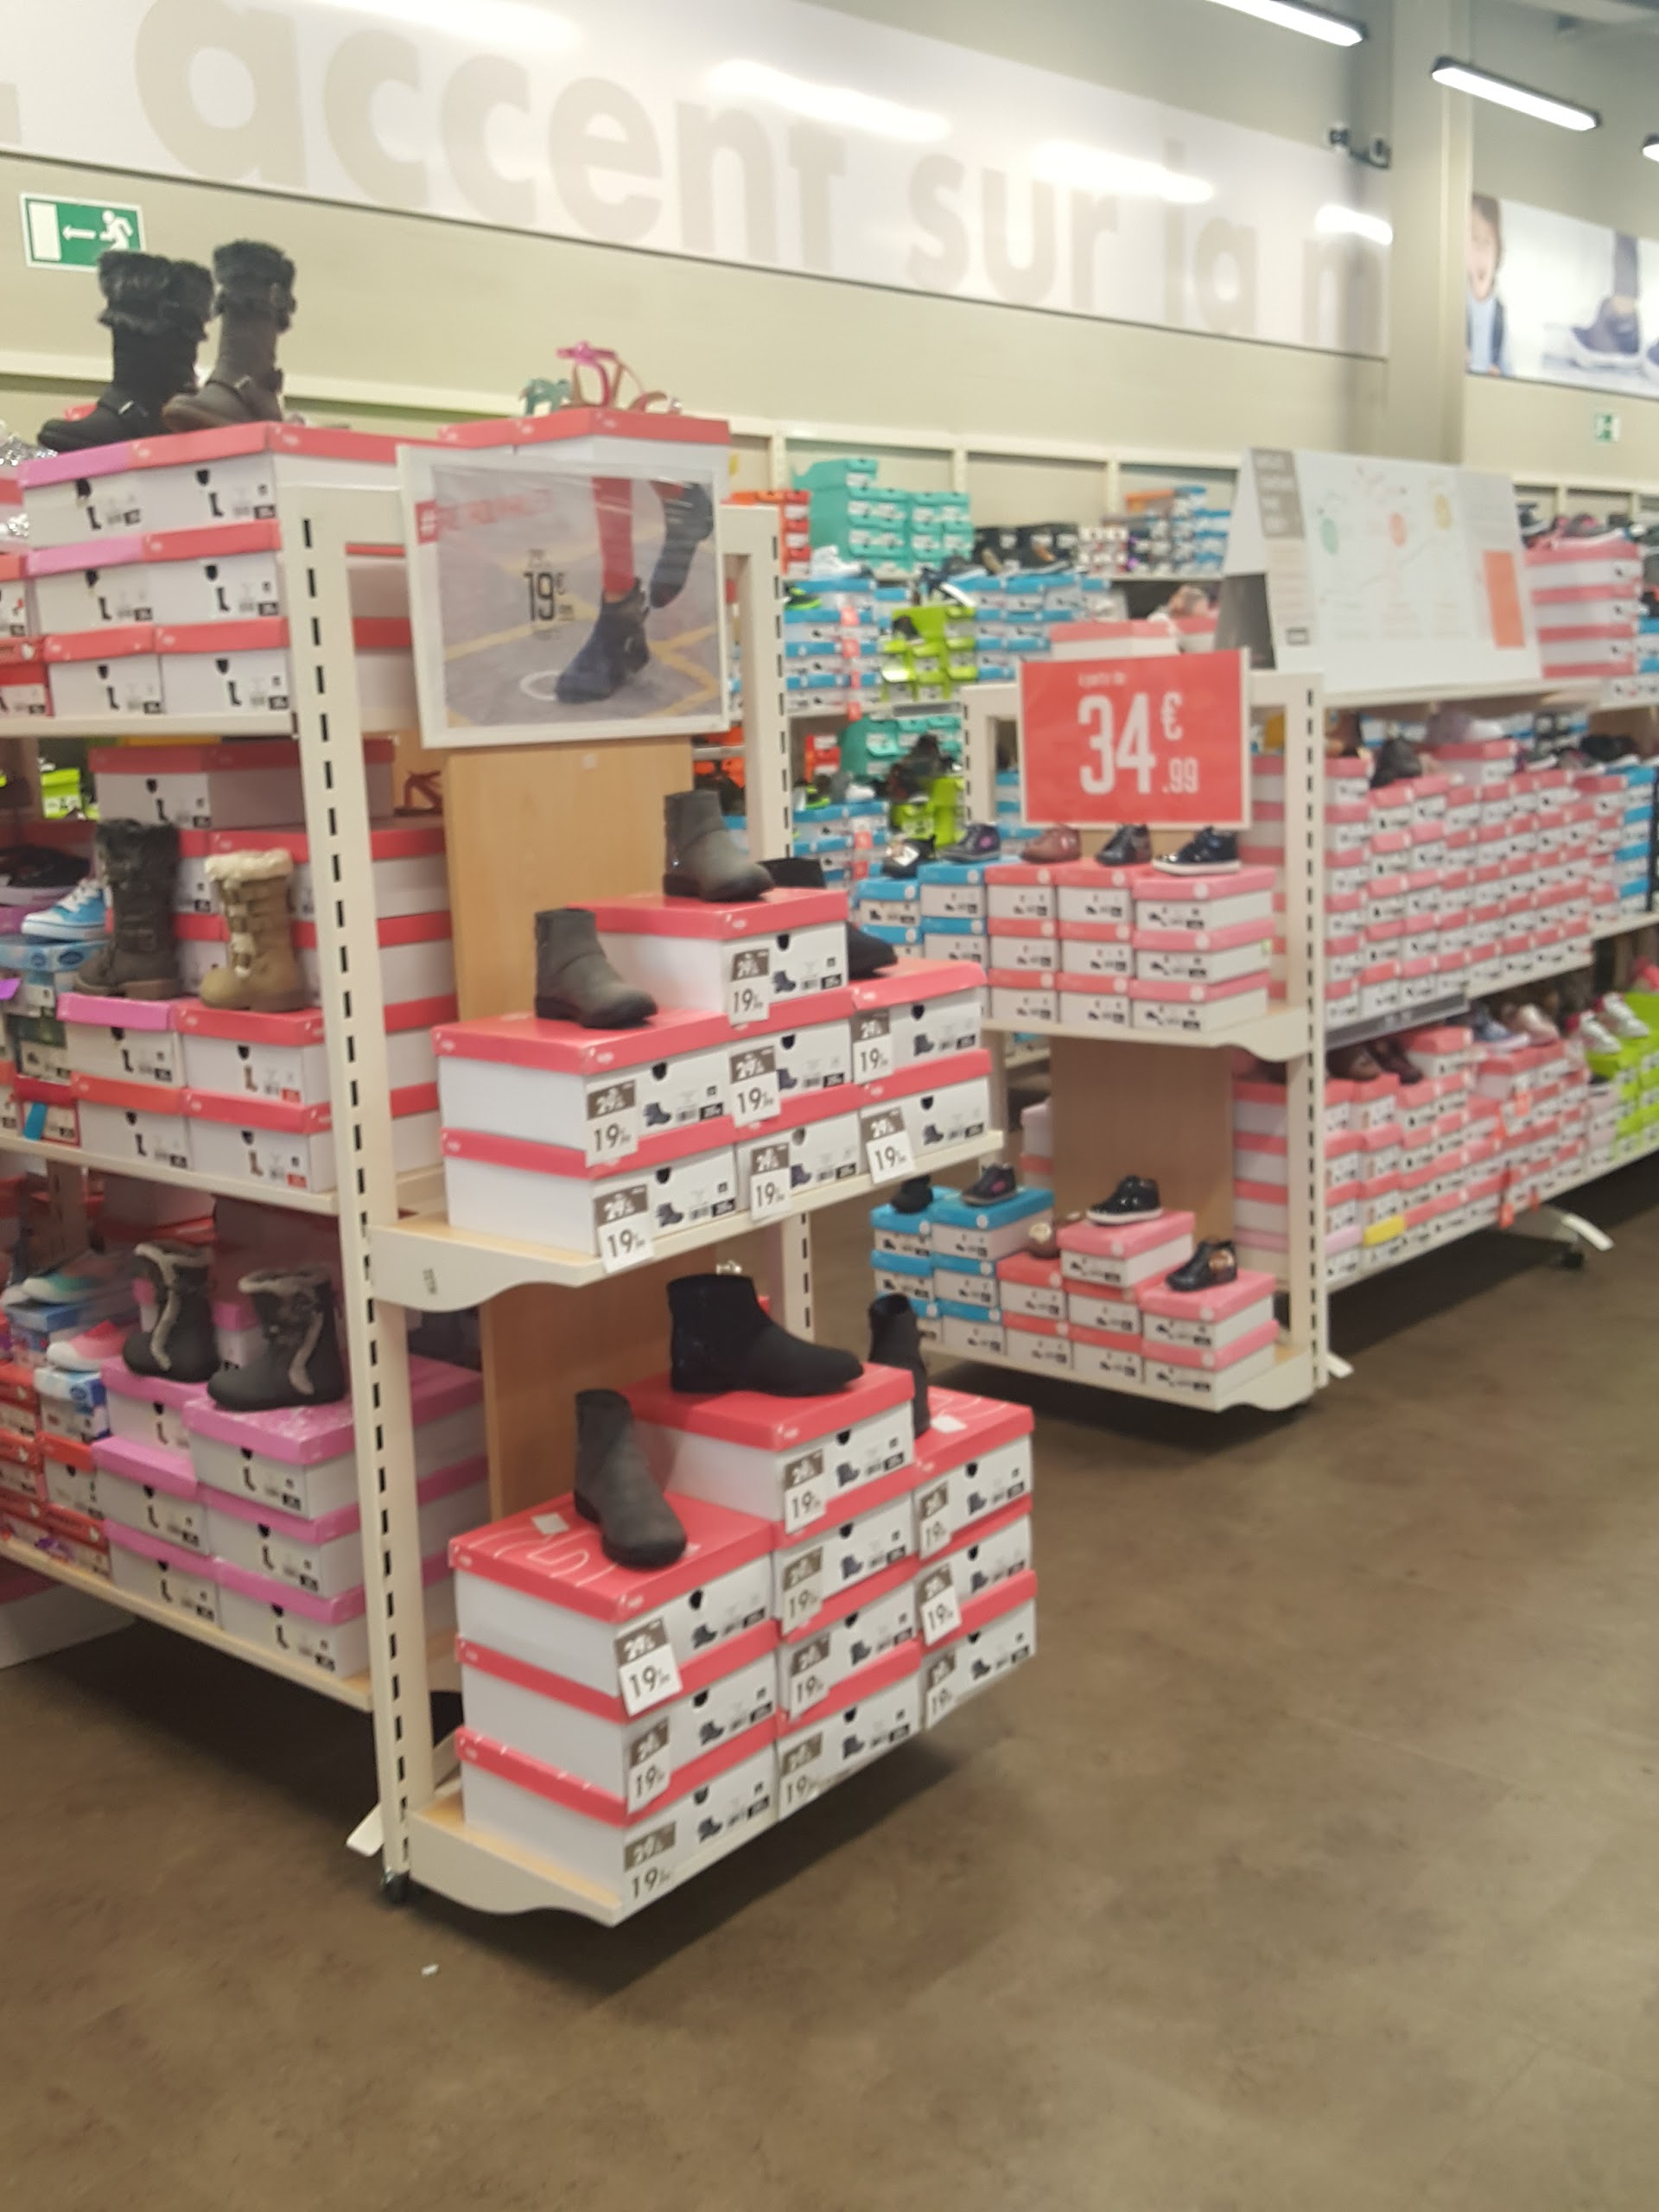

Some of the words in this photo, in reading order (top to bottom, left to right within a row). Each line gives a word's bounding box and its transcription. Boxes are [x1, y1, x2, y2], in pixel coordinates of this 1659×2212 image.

[135, 0, 847, 271] accent
[906, 152, 1121, 309] sur
[523, 571, 555, 621] 19
[1077, 691, 1156, 795] 34
[1160, 691, 1183, 741] €
